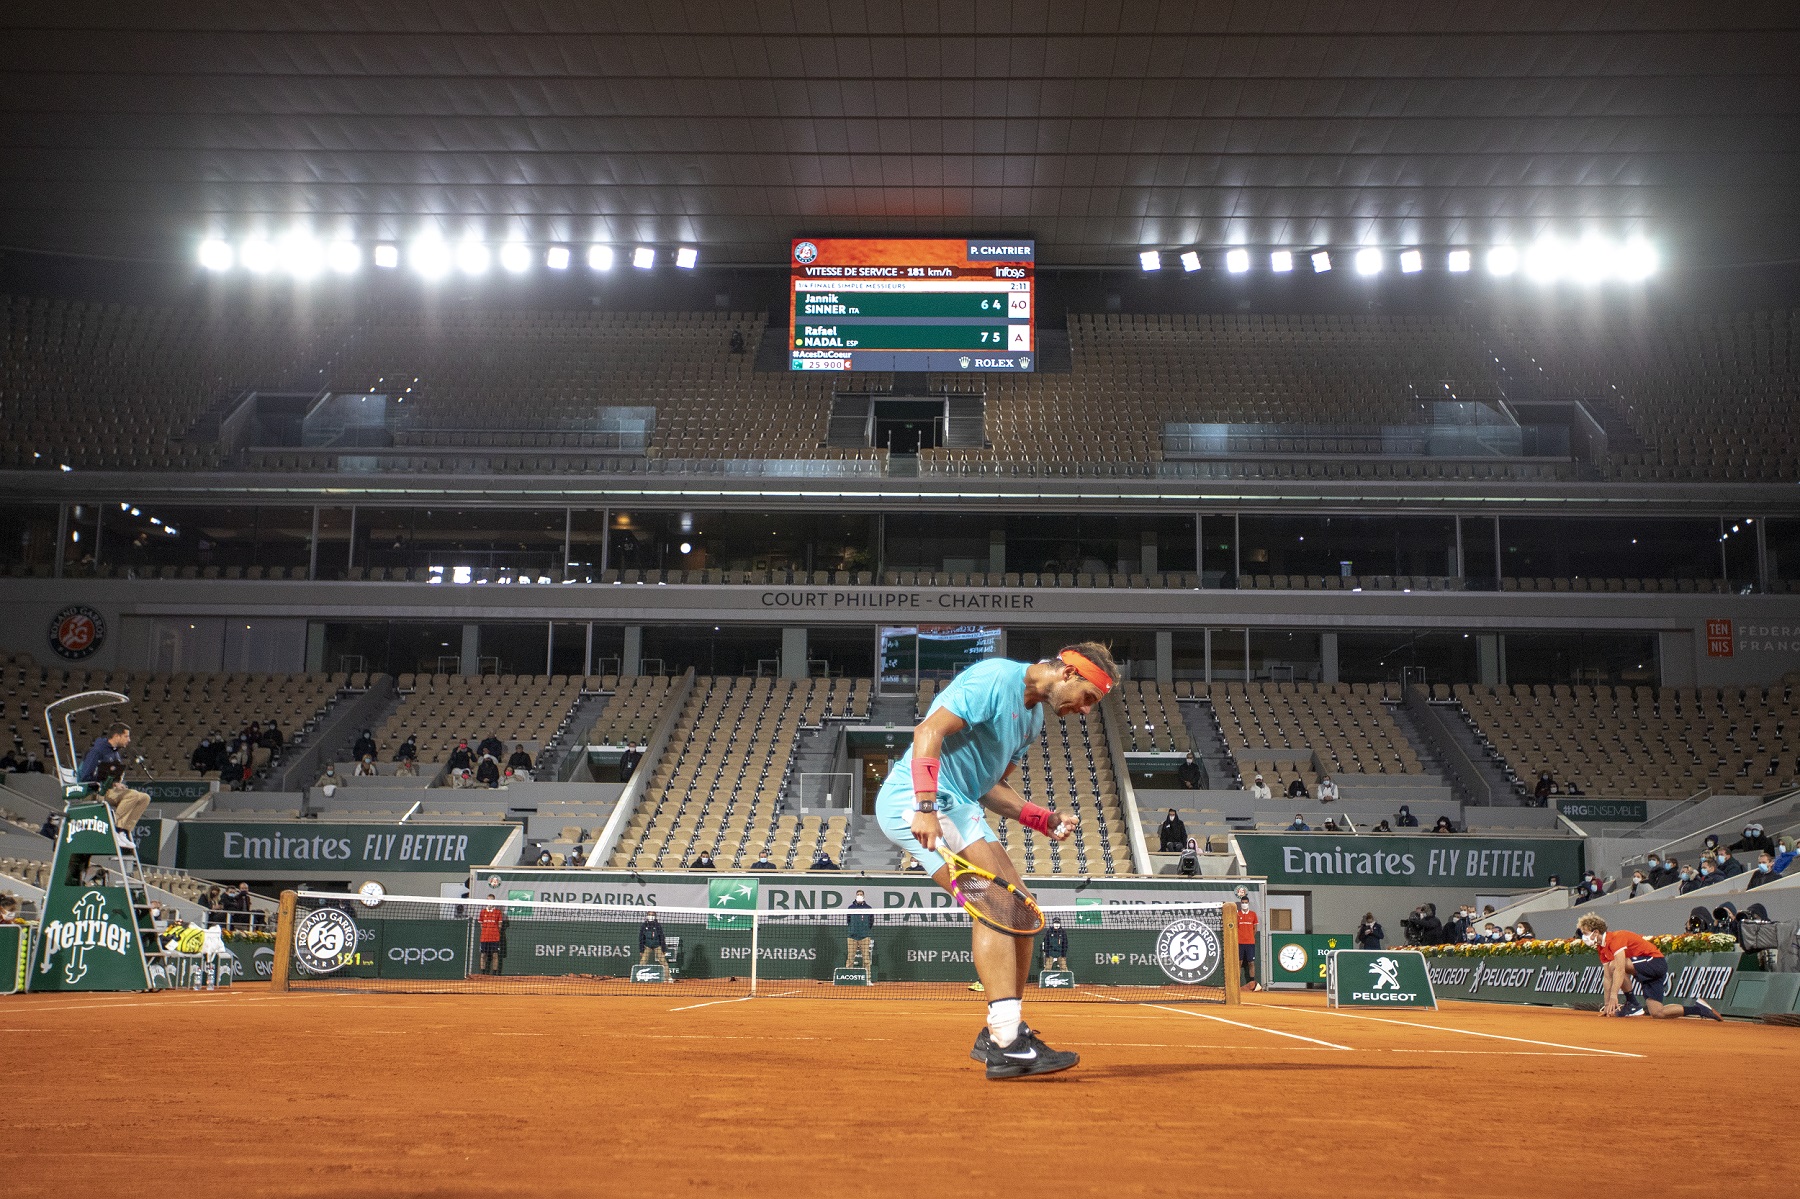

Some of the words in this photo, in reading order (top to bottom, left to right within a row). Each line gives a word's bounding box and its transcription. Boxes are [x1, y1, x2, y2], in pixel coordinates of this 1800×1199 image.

[970, 246, 979, 254] P.
[981, 246, 1031, 255] CHATRIER
[805, 267, 843, 276] VITESSE
[844, 267, 858, 276] DE
[859, 267, 898, 276] SERVICE
[907, 267, 925, 276] 181
[928, 267, 952, 276] km/h
[805, 294, 838, 303] Jannik
[804, 305, 846, 314] SINNER
[980, 300, 989, 310] 6
[992, 300, 1001, 310] 4
[805, 326, 837, 336] Rafael
[980, 332, 989, 342] 7
[992, 332, 1001, 342] 5
[1014, 334, 1023, 342] A
[804, 337, 844, 347] NADAL
[792, 350, 852, 359] #AcesDuCoeur
[974, 359, 1014, 368] ROLEX
[761, 592, 828, 607] COURT
[834, 593, 920, 607] PHILIPPE
[938, 594, 1034, 609] CHATRIER
[1709, 623, 1728, 635] TEN
[1711, 641, 1729, 653] NIS
[1563, 805, 1640, 816] #RGENSEMBLE
[223, 831, 351, 860] Emirates
[362, 834, 396, 861] FLY
[400, 834, 469, 861] BETTER
[1282, 845, 1416, 875] Emirates
[1428, 849, 1460, 876] FLY
[1466, 849, 1536, 877] BETTER
[298, 912, 327, 947] ROLAND
[329, 912, 354, 947] GARROS
[1160, 922, 1186, 958] ROLAND
[1188, 922, 1217, 957] GARROS
[388, 947, 455, 965] oppo
[535, 944, 566, 957] BNP
[568, 944, 631, 958] PARIBAS
[720, 947, 752, 959] BNP
[756, 947, 817, 960] PARIBAS
[907, 950, 938, 962] BNP
[941, 950, 974, 962] PARI
[1170, 965, 1209, 978] PARIS
[1480, 967, 1535, 988] PEUGEOT
[1534, 965, 1580, 994] Emirates
[1689, 966, 1732, 999] BETTER
[1352, 992, 1417, 1002] PEUGEOT
